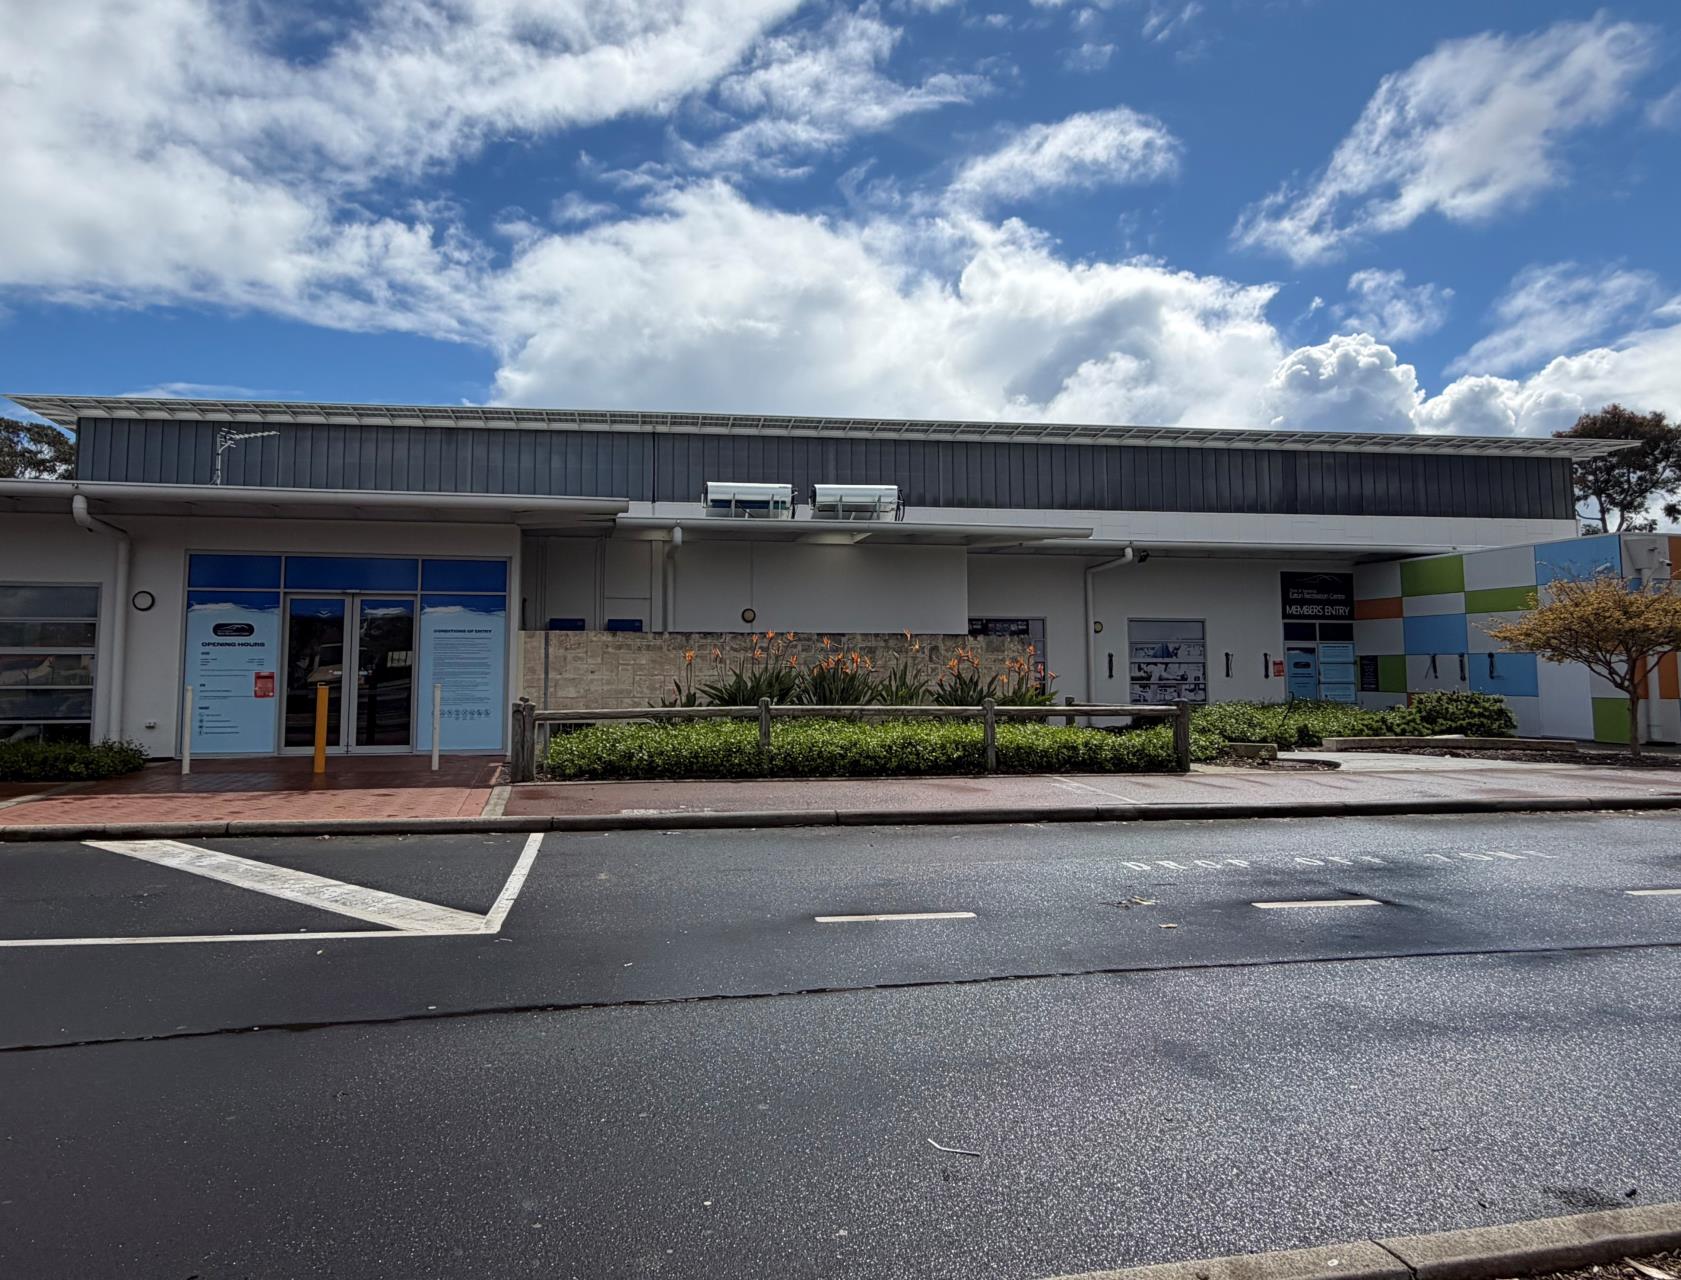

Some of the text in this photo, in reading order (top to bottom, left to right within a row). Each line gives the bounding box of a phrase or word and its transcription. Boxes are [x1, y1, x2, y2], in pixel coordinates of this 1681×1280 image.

[1286, 604, 1350, 616] MEMBERS ENTRY
[1120, 859, 1250, 870] DROP
